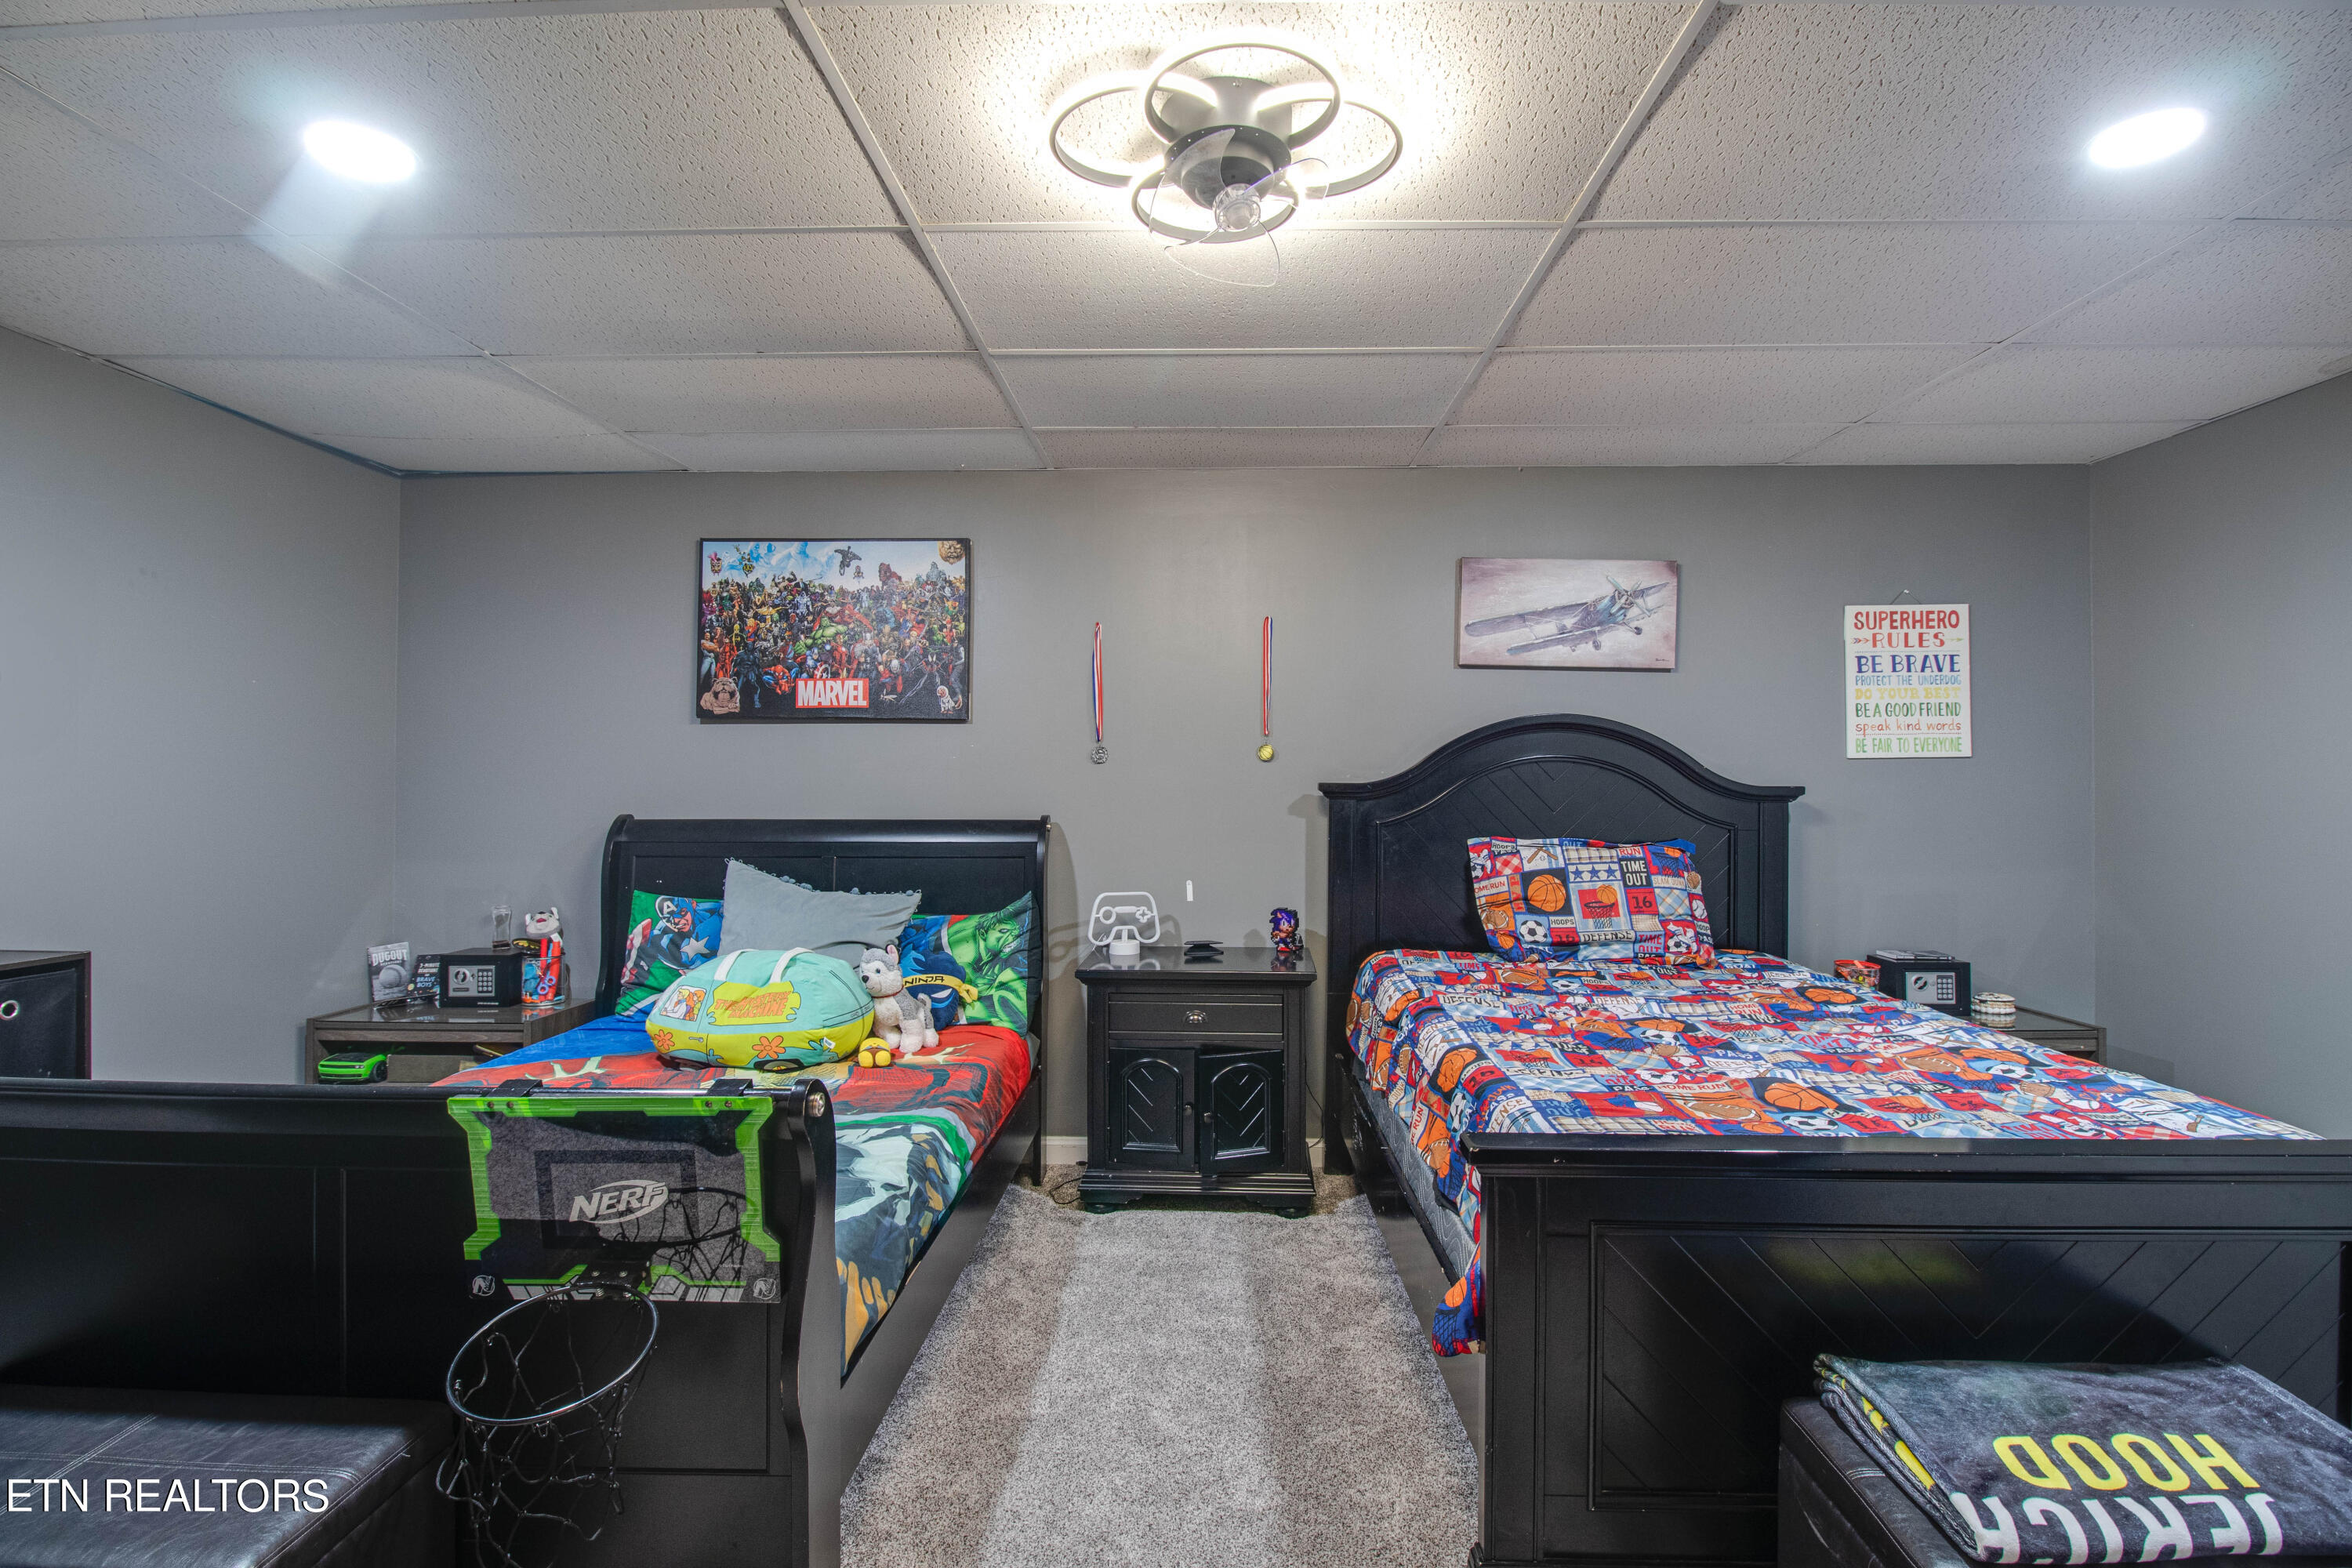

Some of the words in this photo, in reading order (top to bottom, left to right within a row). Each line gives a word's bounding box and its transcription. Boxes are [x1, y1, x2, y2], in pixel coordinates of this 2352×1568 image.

[1853, 610, 1960, 630] SUPERHERO
[1871, 632, 1946, 648] RULES
[1855, 655, 1882, 673] BE
[1890, 655, 1961, 673] BRAVE
[1855, 675, 1892, 686] PROTECT
[1896, 675, 1913, 686] THE
[1918, 674, 1962, 686] UNDERDOG
[797, 680, 867, 706] MARVEL
[1855, 688, 1872, 700] DO
[1878, 688, 1920, 700] YOUR
[1923, 687, 1962, 699] BEST
[1856, 702, 1871, 717] BE
[1872, 702, 1882, 717] A
[1885, 702, 1917, 717] GOOD
[1919, 702, 1962, 717] FRIEND
[1856, 719, 1891, 737] speak
[1896, 718, 1921, 731] kind
[1926, 718, 1962, 731] words
[1856, 738, 1867, 753] BE
[1872, 737, 1893, 753] FAIR
[1896, 737, 1910, 753] TO
[1914, 736, 1962, 753] EVERYONE
[1621, 860, 1647, 873] TIME
[1490, 880, 1506, 889] RUN
[1625, 873, 1647, 886] OUT
[1632, 895, 1653, 909] 16
[1583, 931, 1633, 942] DEFENSE
[1639, 934, 1662, 945] TIME
[372, 949, 408, 967] DUGOUT
[904, 975, 945, 986] NINJA
[714, 998, 739, 1011] THE
[728, 999, 788, 1018] MACHINE
[1413, 1106, 1425, 1131] RUN
[569, 1181, 668, 1223] NERF
[1992, 1433, 2261, 1491] HOOD
